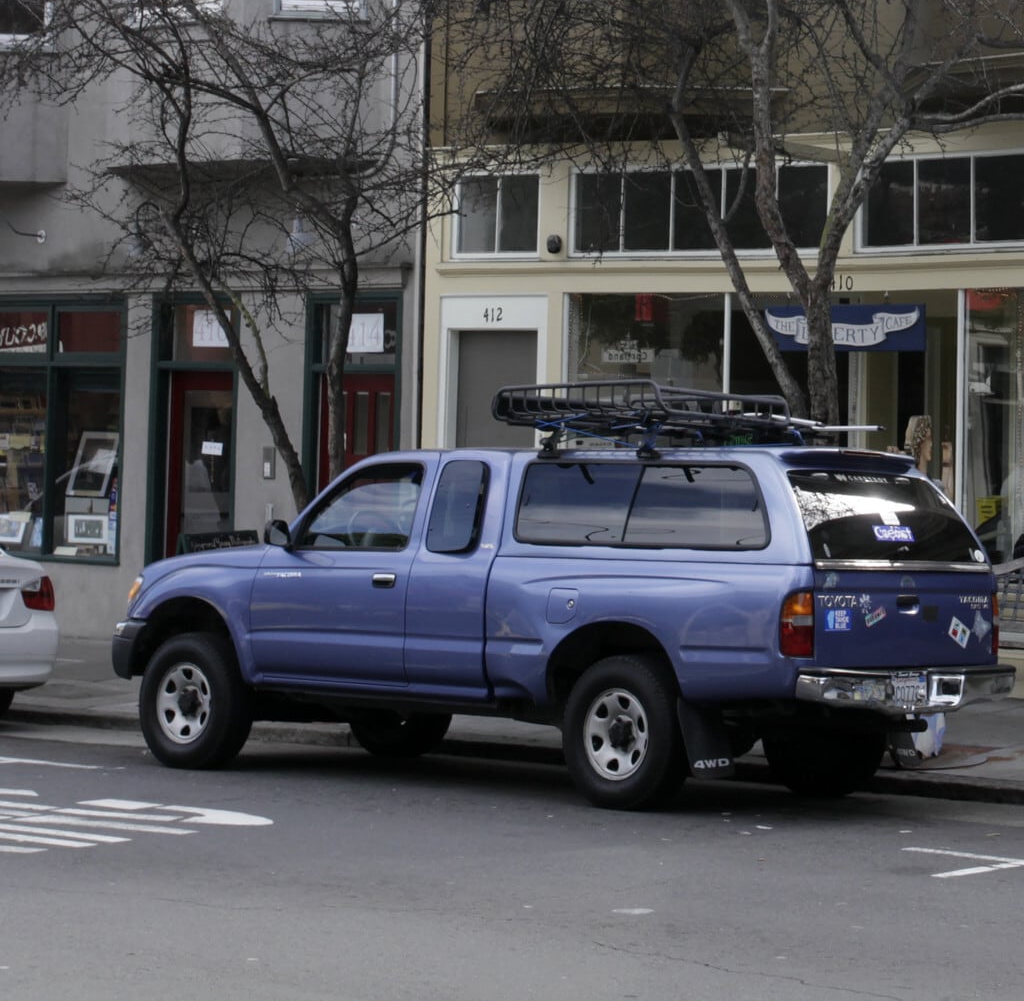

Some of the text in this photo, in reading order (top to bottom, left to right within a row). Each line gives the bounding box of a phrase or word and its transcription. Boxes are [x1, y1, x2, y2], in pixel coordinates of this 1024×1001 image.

[483, 307, 503, 323] 412
[774, 319, 795, 332] THE
[885, 316, 912, 330] CAFE
[801, 325, 879, 343] LERTY
[818, 595, 857, 607] TOYOTA
[693, 758, 731, 769] 4WD
